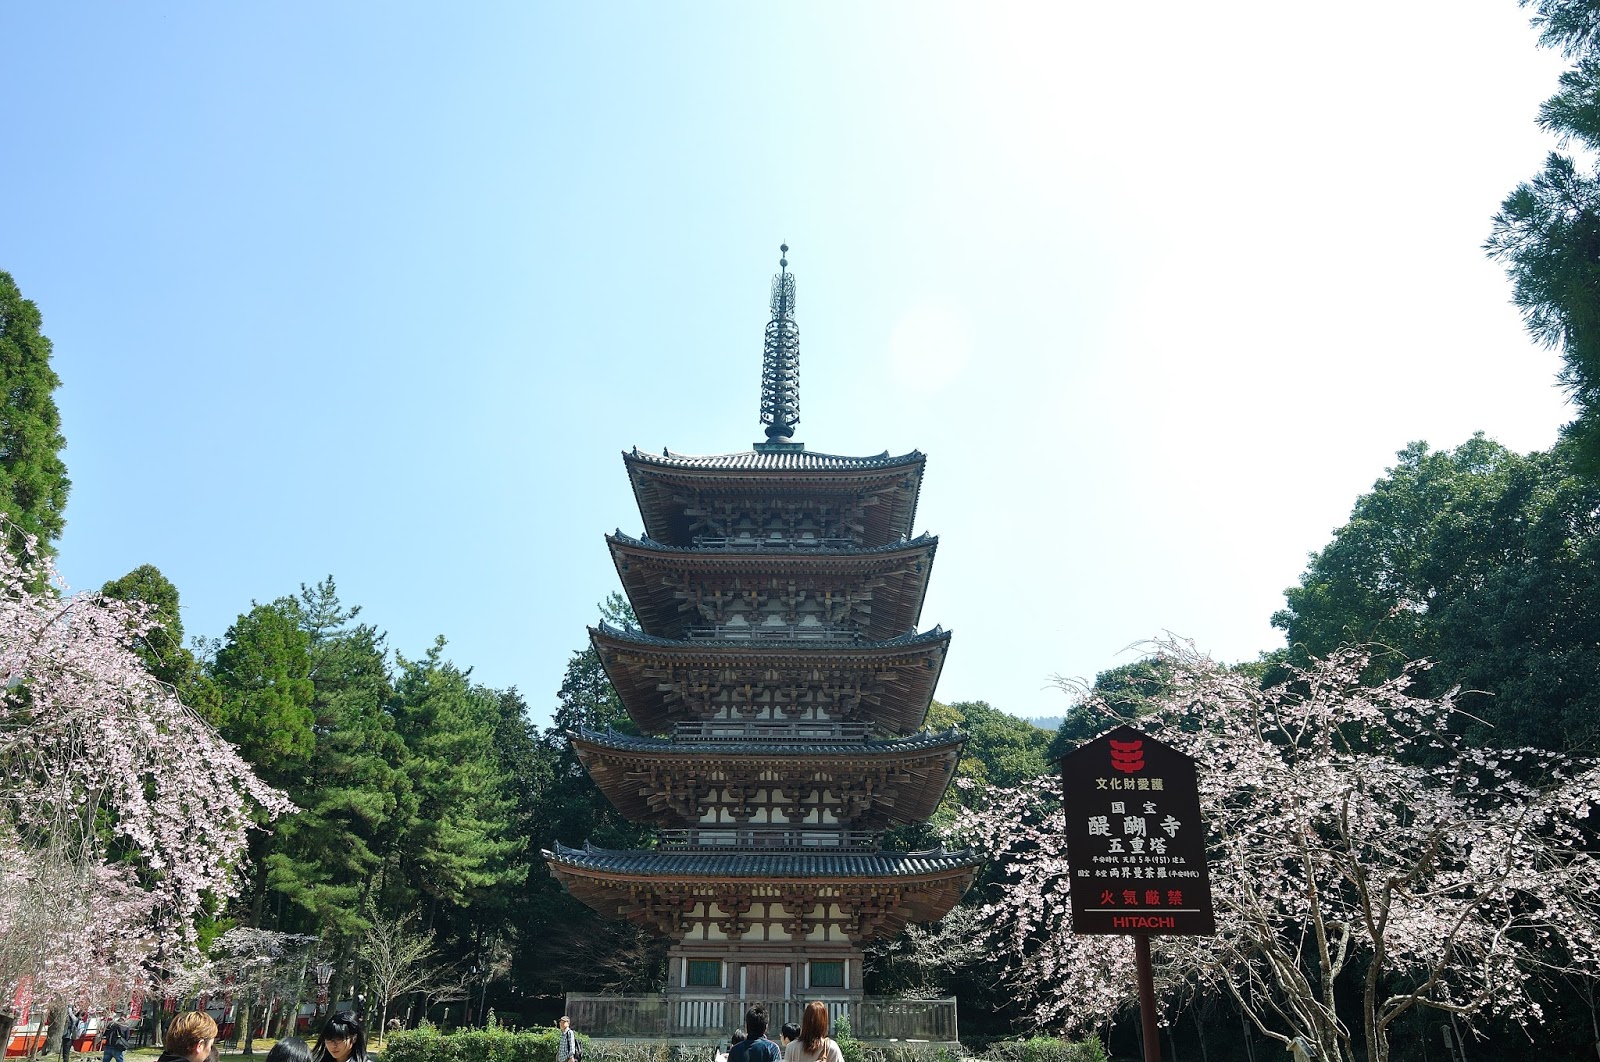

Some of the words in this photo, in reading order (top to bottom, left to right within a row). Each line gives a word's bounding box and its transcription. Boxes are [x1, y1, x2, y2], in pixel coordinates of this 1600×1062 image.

[1095, 777, 1164, 791] 文化財愛護
[1111, 801, 1157, 814] 国宝
[1087, 815, 1182, 838] 醍醐寺
[1108, 837, 1168, 854] 五重塔
[1100, 890, 1183, 905] 火気厳禁
[1113, 916, 1175, 928] HITACHI
